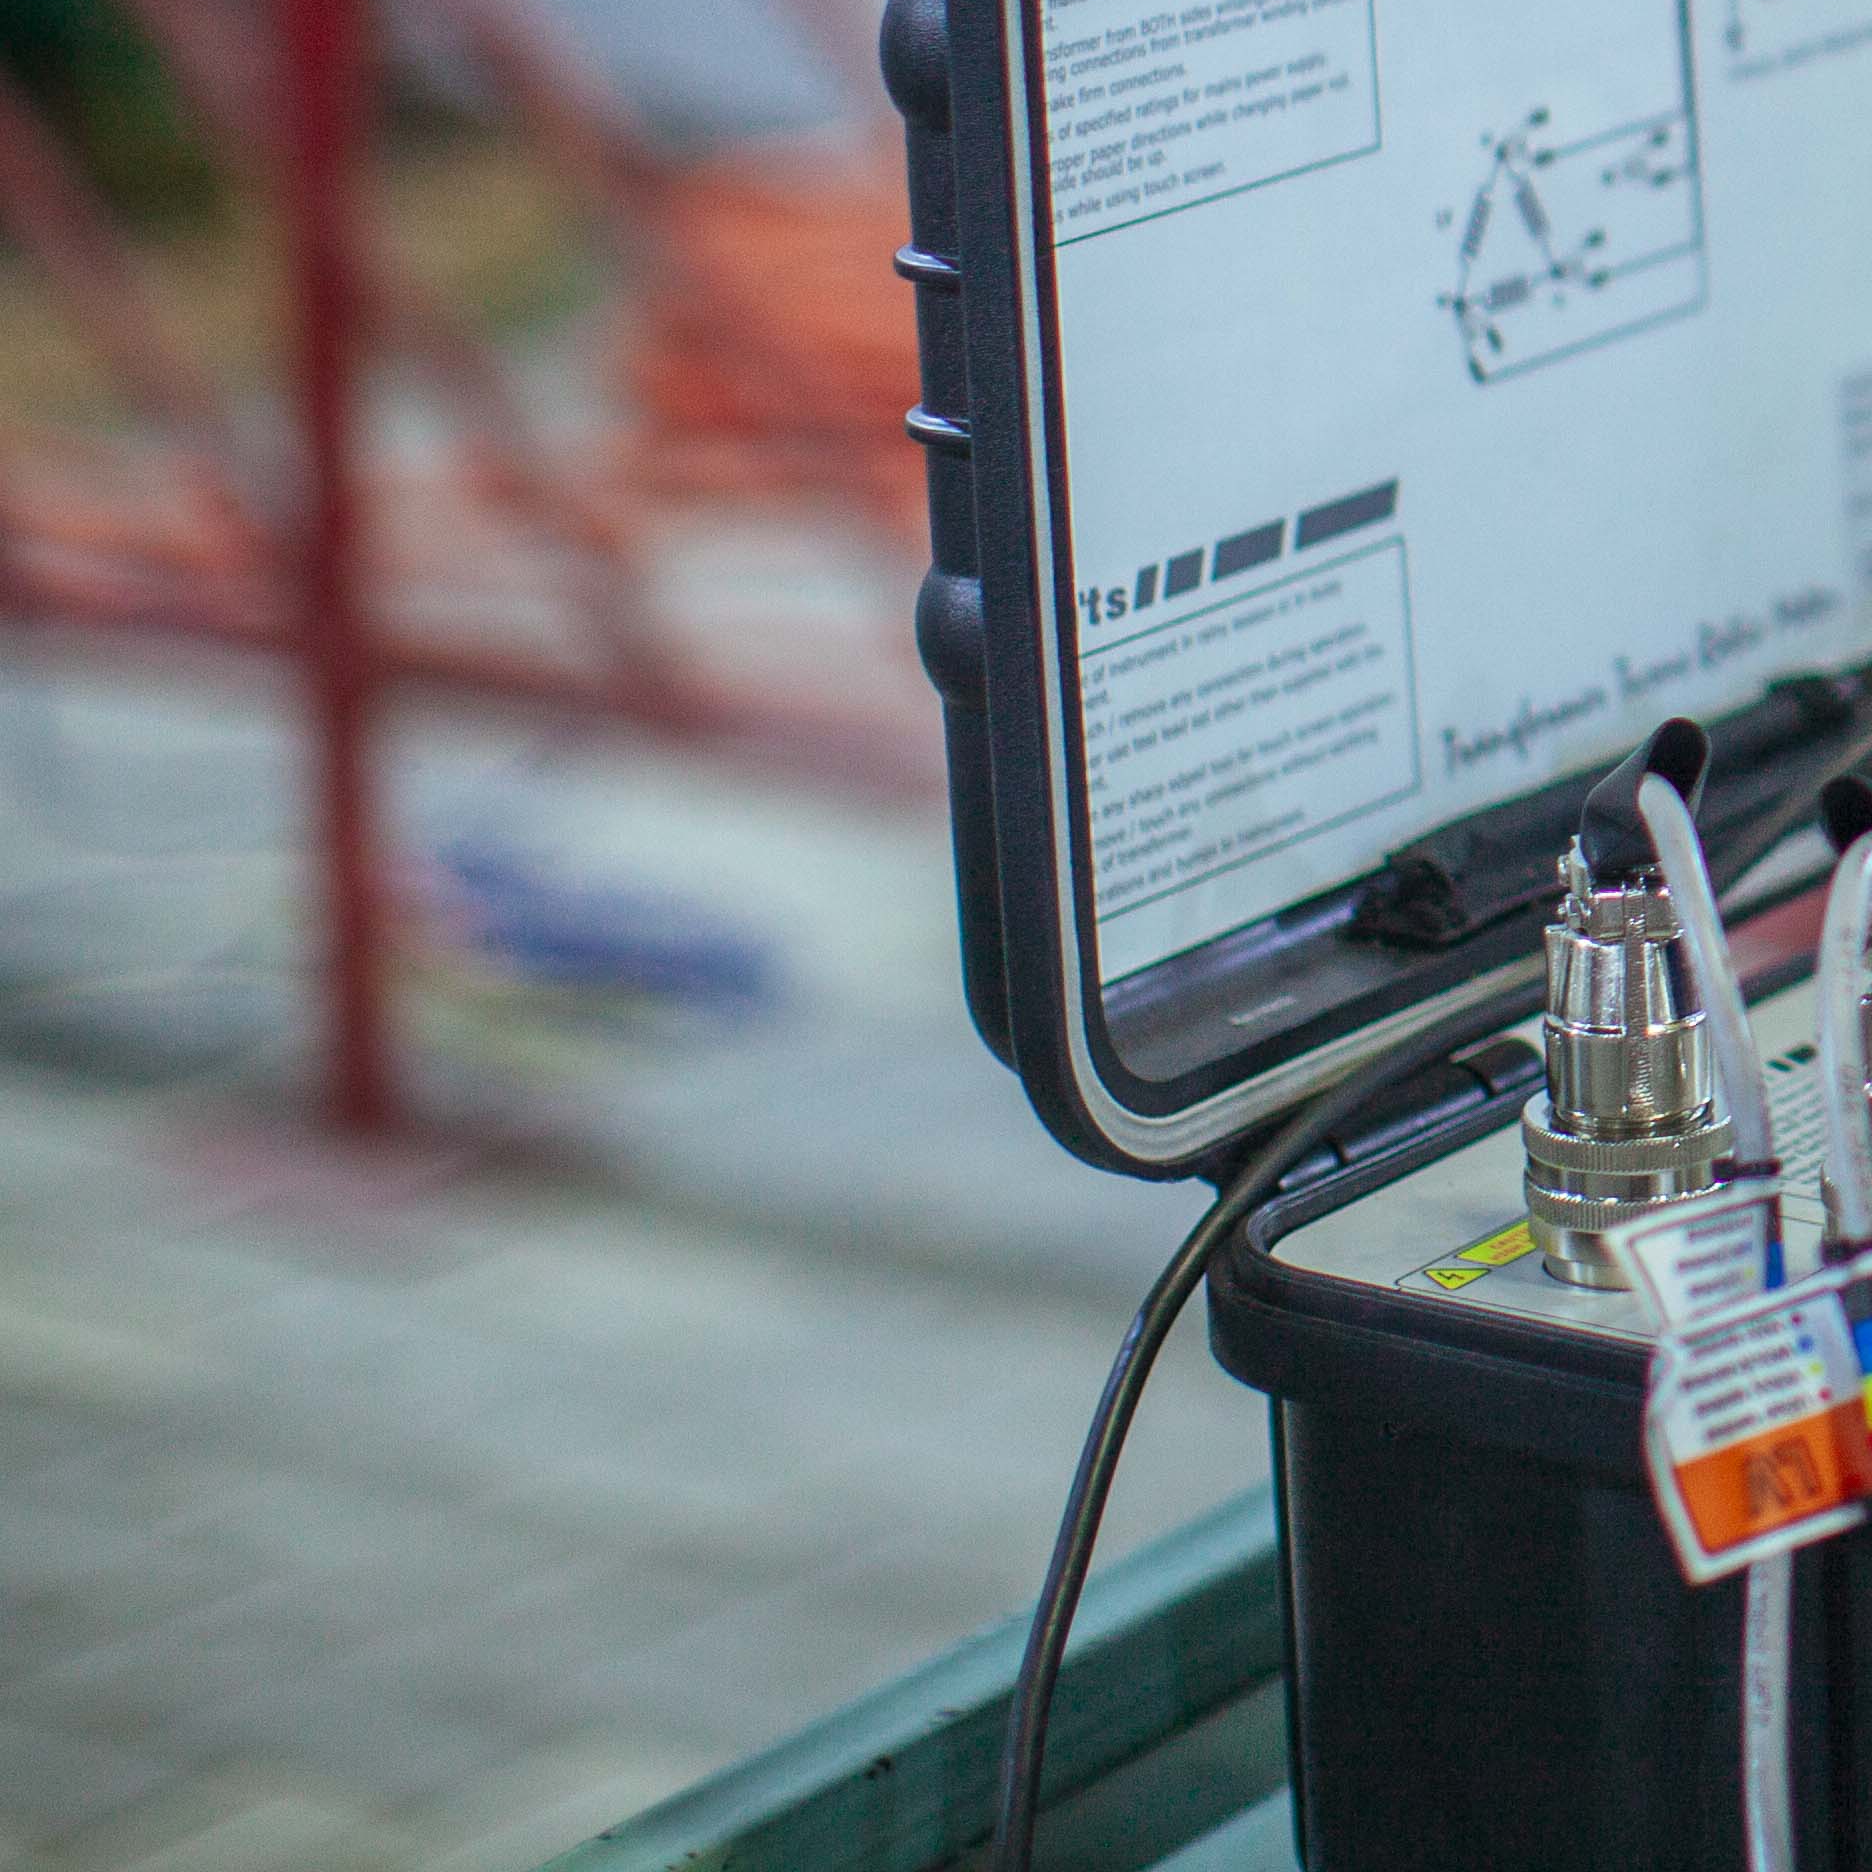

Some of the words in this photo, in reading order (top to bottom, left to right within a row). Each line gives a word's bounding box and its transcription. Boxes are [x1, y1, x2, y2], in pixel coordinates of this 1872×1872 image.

[1070, 44, 1146, 76] connections
[1149, 34, 1180, 54] from
[1183, 12, 1258, 43] transformer
[1105, 25, 1137, 44] from
[1140, 16, 1177, 37] BOTH
[1078, 84, 1105, 104] firm
[1075, 107, 1133, 137] specified
[1135, 95, 1180, 119] ratings
[1090, 140, 1127, 164] paper
[1131, 121, 1193, 150] directions
[1196, 109, 1228, 131] while
[1081, 161, 1124, 184] should
[1127, 153, 1143, 171] be
[1068, 198, 1102, 218] while
[1105, 186, 1140, 208] using
[1143, 173, 1179, 196] touch
